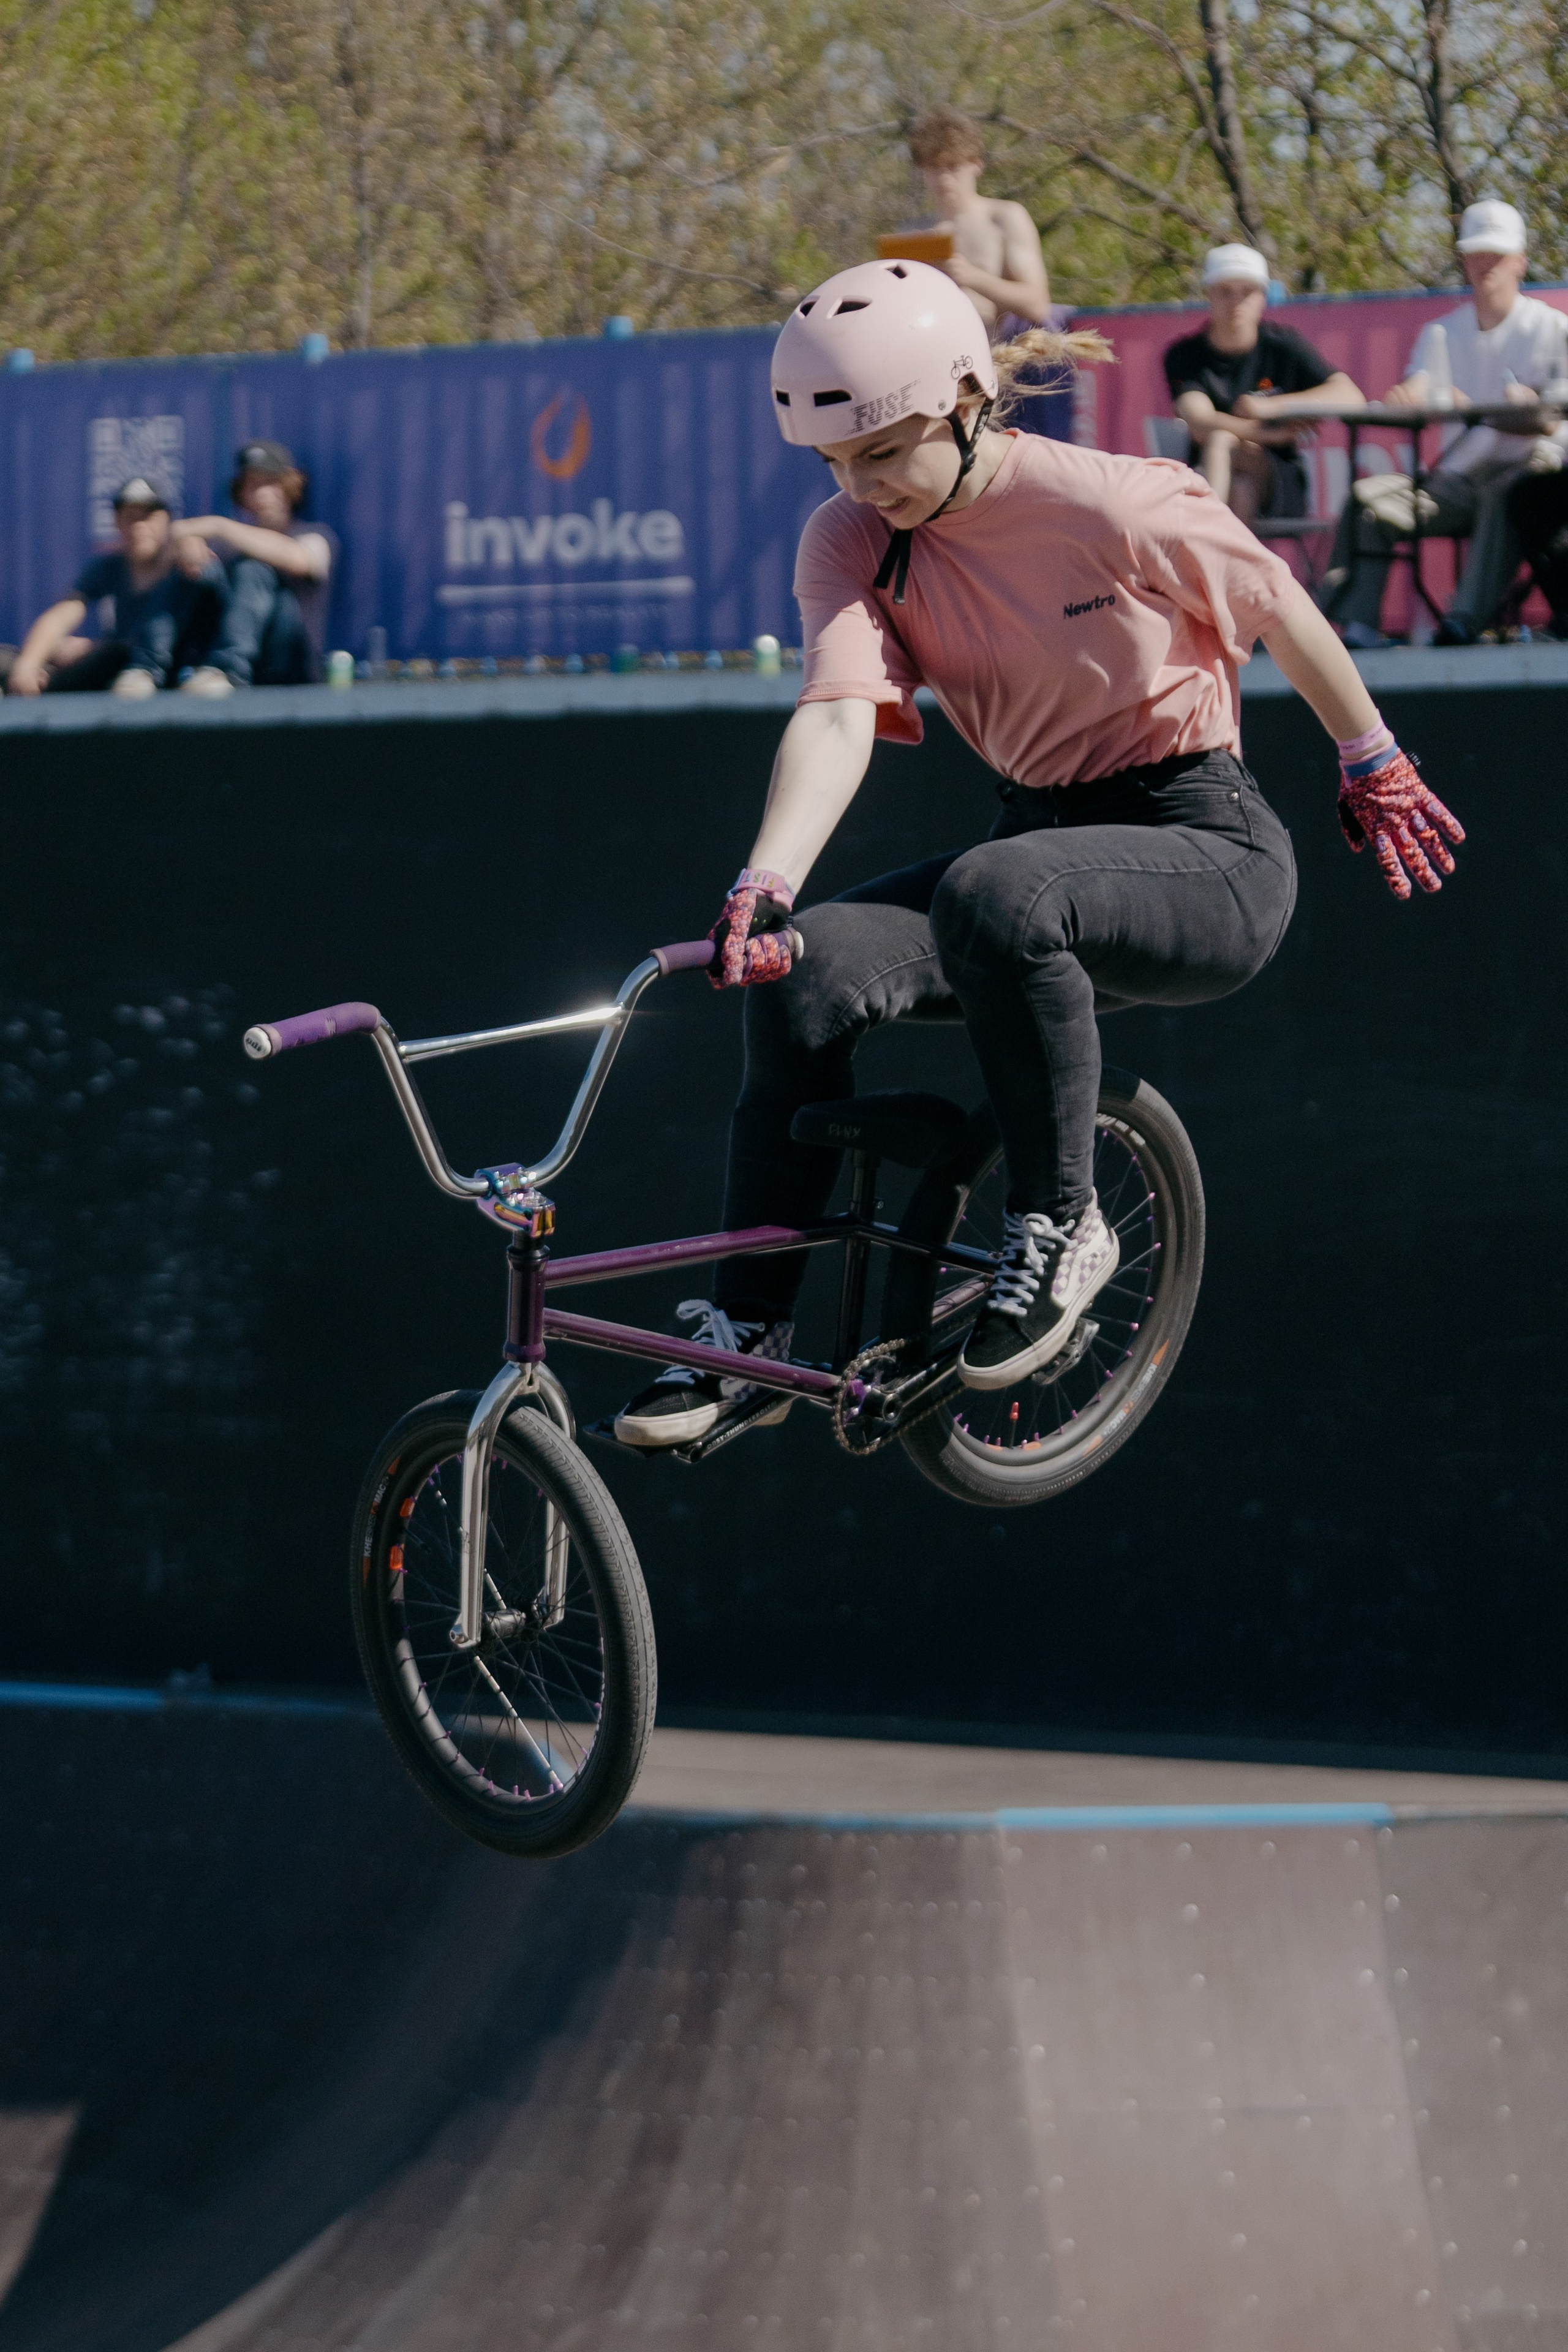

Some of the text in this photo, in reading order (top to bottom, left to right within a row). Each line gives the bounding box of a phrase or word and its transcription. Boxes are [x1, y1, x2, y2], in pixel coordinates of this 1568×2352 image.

[845, 379, 920, 435] FUSE
[445, 497, 683, 569] invoke
[1063, 594, 1115, 619] Newtro
[743, 872, 775, 888] FIST
